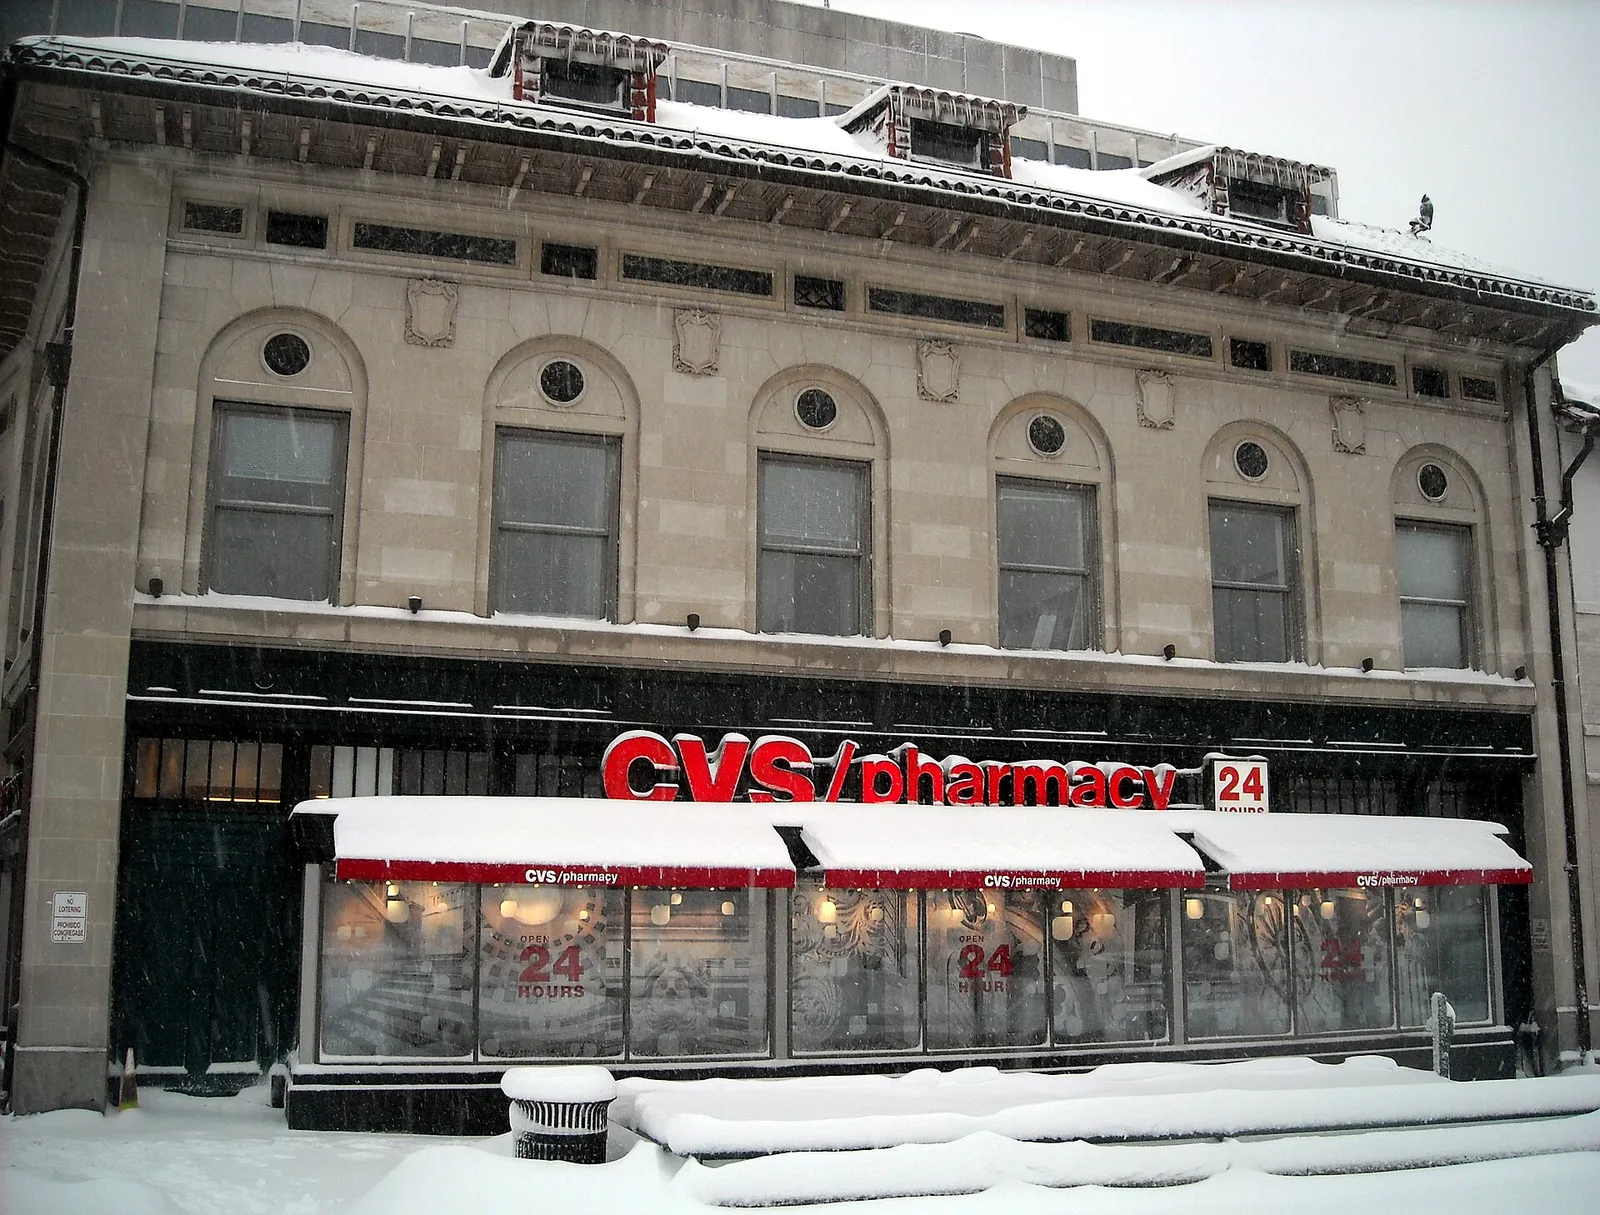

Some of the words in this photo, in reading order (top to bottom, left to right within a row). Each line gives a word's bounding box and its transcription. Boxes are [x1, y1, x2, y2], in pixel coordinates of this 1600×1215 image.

[602, 733, 1176, 810] CVS/pharmacy
[1219, 766, 1264, 801] 24
[525, 869, 618, 884] CVS/pharmacy
[984, 875, 1061, 887] CVS/pharmacy
[1357, 874, 1418, 886] CVS/pharmacy
[520, 935, 550, 943] OPEN
[519, 944, 584, 982] 24
[959, 944, 1013, 978] 24
[518, 985, 584, 998] HOURS
